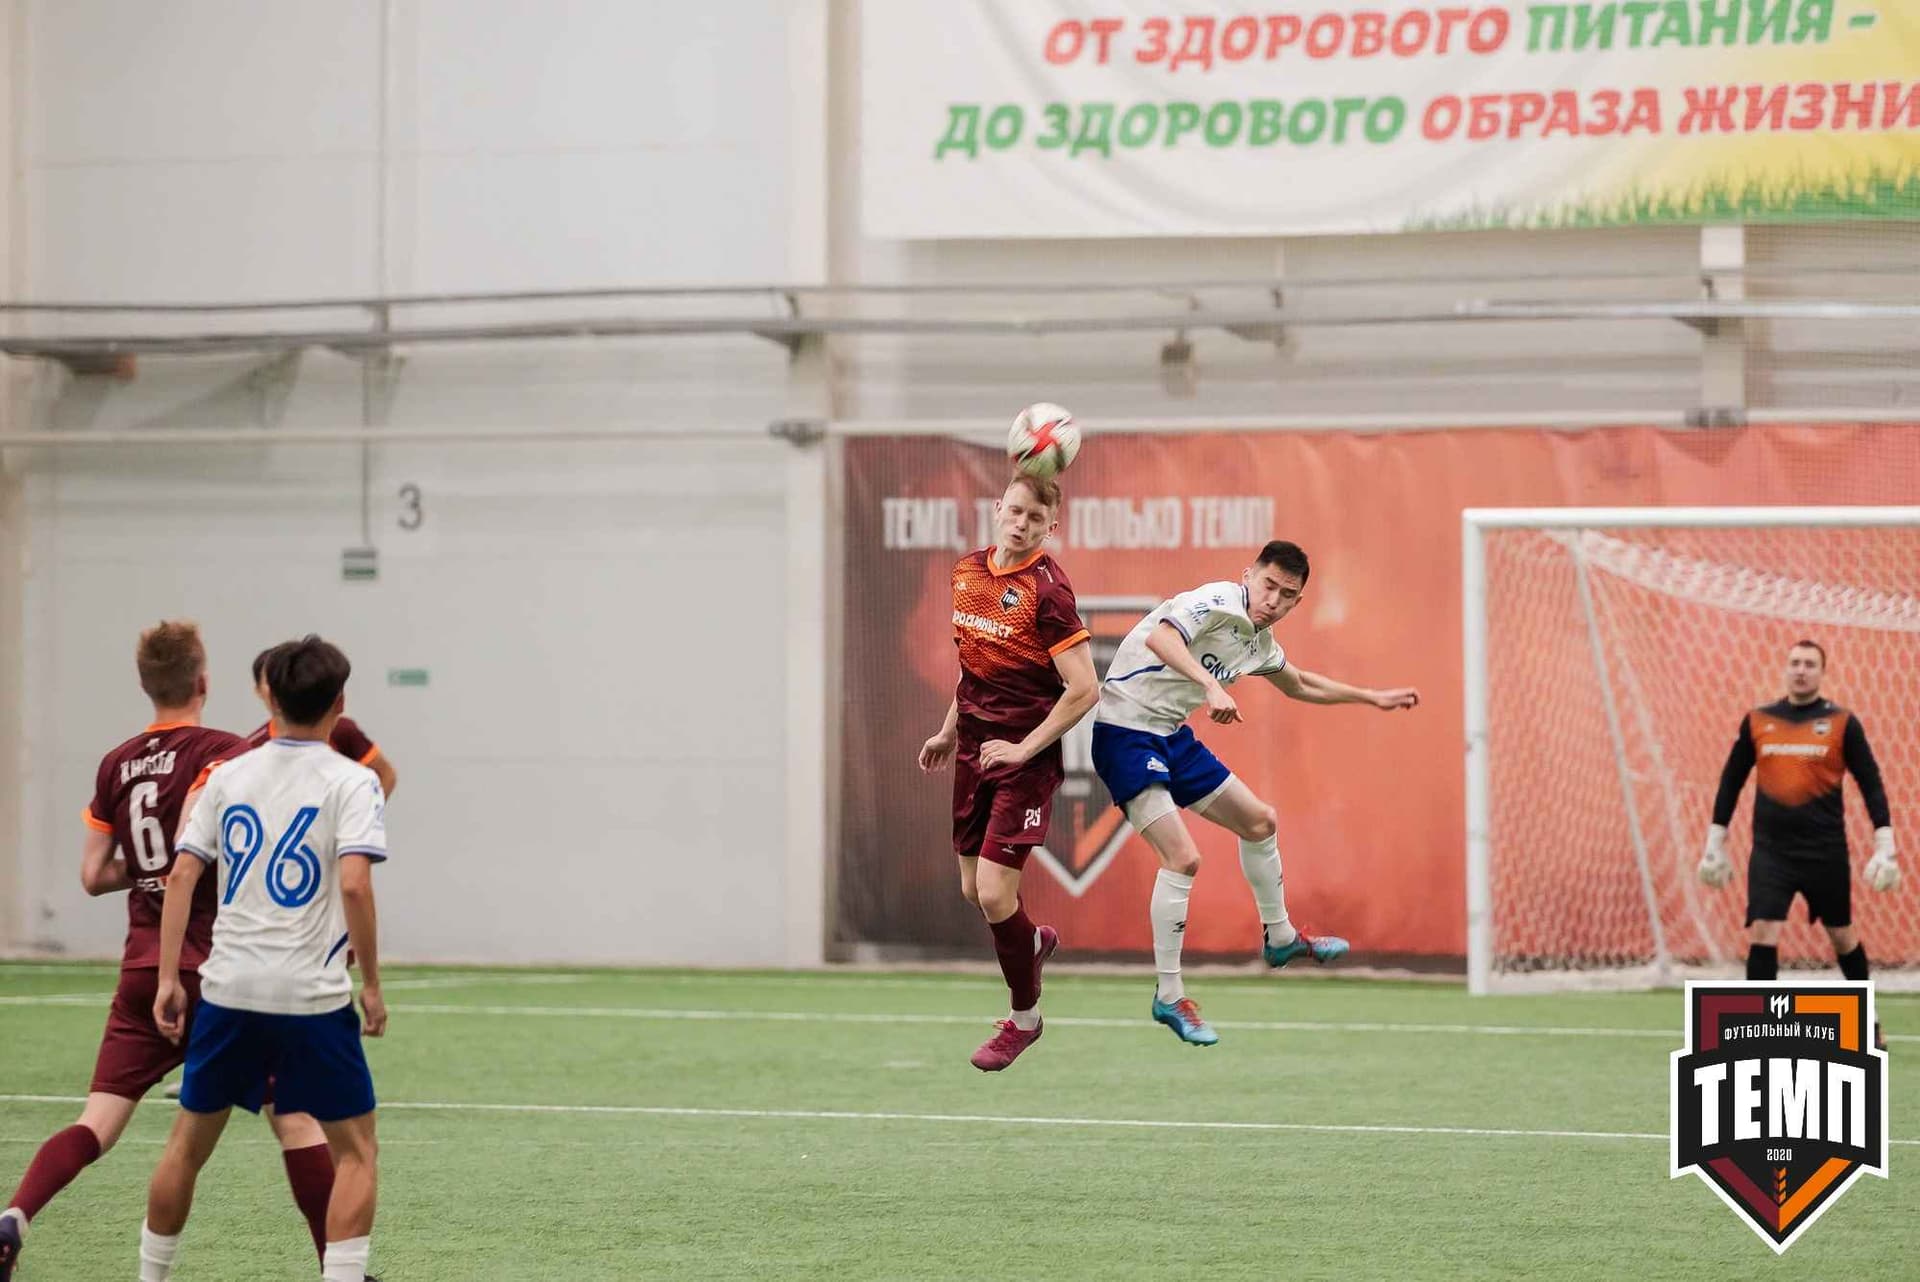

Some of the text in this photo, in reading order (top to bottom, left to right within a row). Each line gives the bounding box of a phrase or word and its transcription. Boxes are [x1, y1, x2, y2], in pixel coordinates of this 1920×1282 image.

[1044, 19, 1122, 64] ОТ
[1135, 8, 1510, 71] ЗДОРОВОГО
[1527, 0, 1835, 52] ПИТАНИЯ
[935, 82, 1920, 160] ДО ЗДОРОВОГО ОБРАЗА ЖИЗНИ
[398, 484, 423, 531] 3
[1067, 496, 1184, 550] ТОЛЬКО
[130, 781, 168, 871] 6
[222, 803, 321, 908] 96
